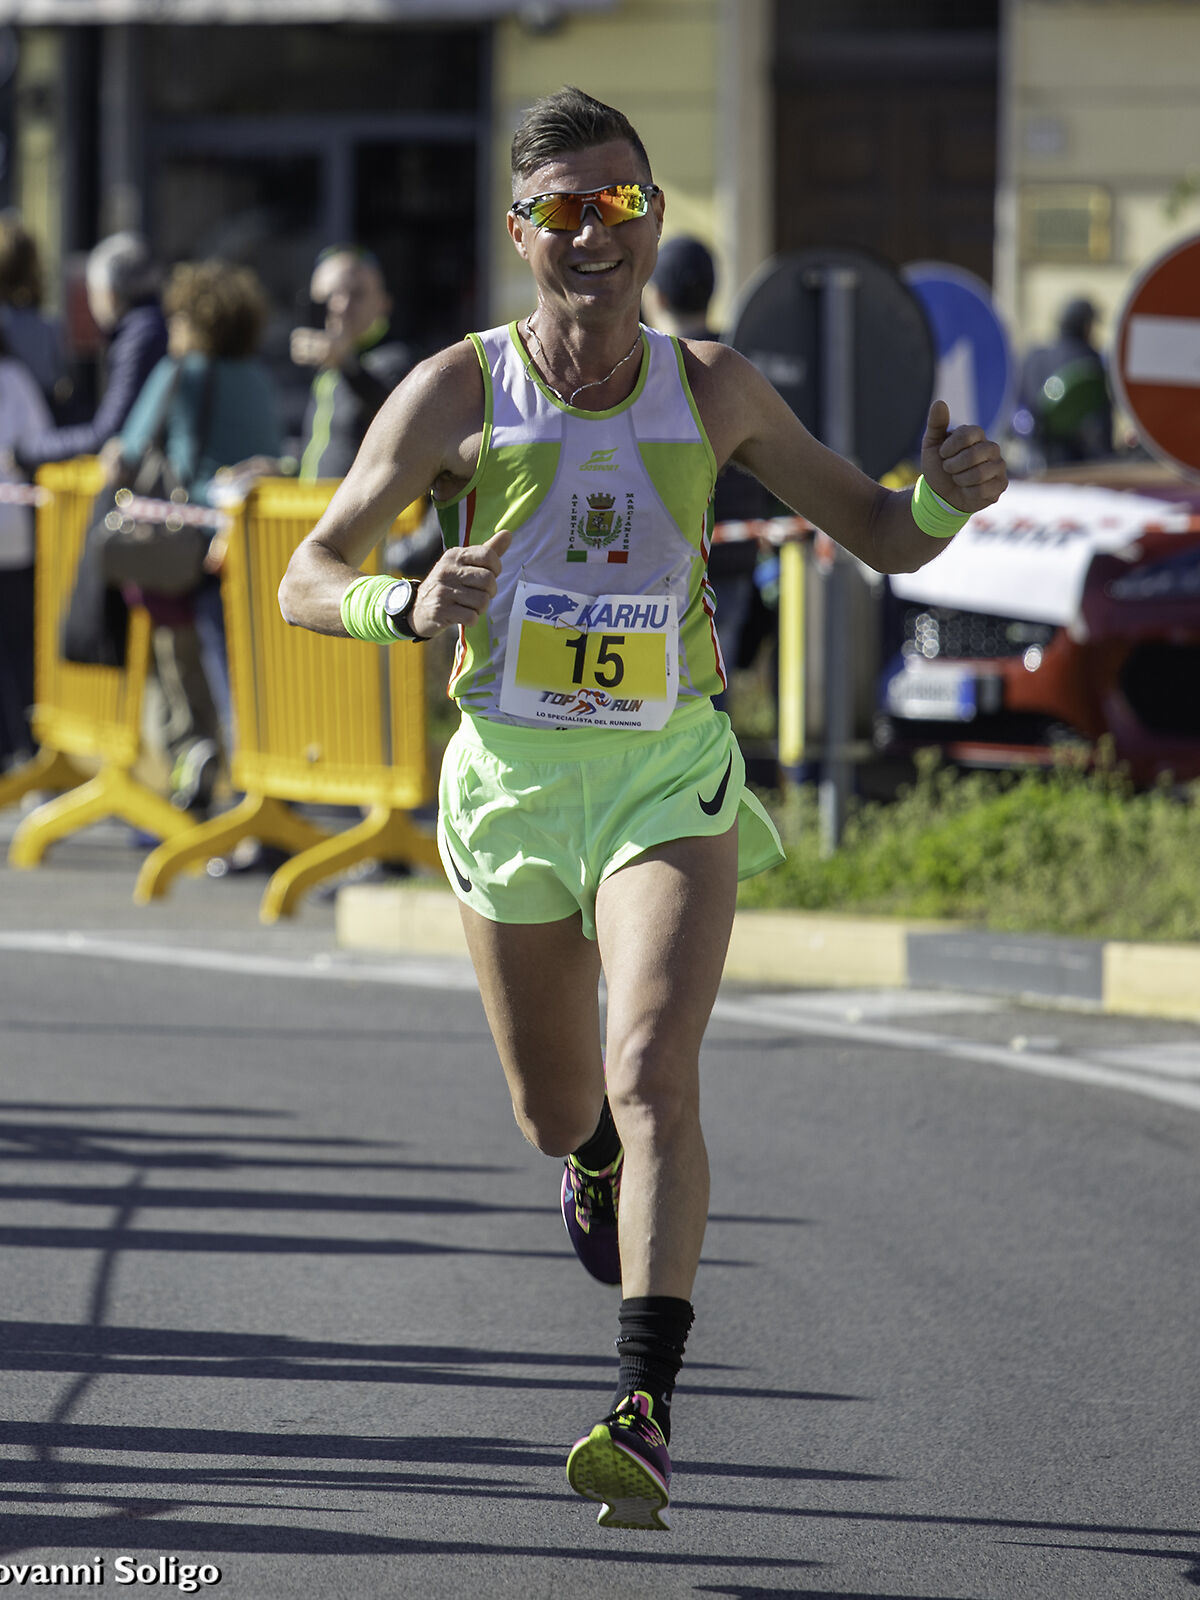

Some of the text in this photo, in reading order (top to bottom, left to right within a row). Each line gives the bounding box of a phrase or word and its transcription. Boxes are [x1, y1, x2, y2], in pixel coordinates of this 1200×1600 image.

[567, 493, 579, 550] ATLETICA
[622, 492, 635, 550] MARCIANISE
[575, 603, 669, 629] KARHU
[565, 633, 626, 688] 15
[540, 690, 644, 712] TOP RUN
[548, 713, 593, 724] SPECIALISTA
